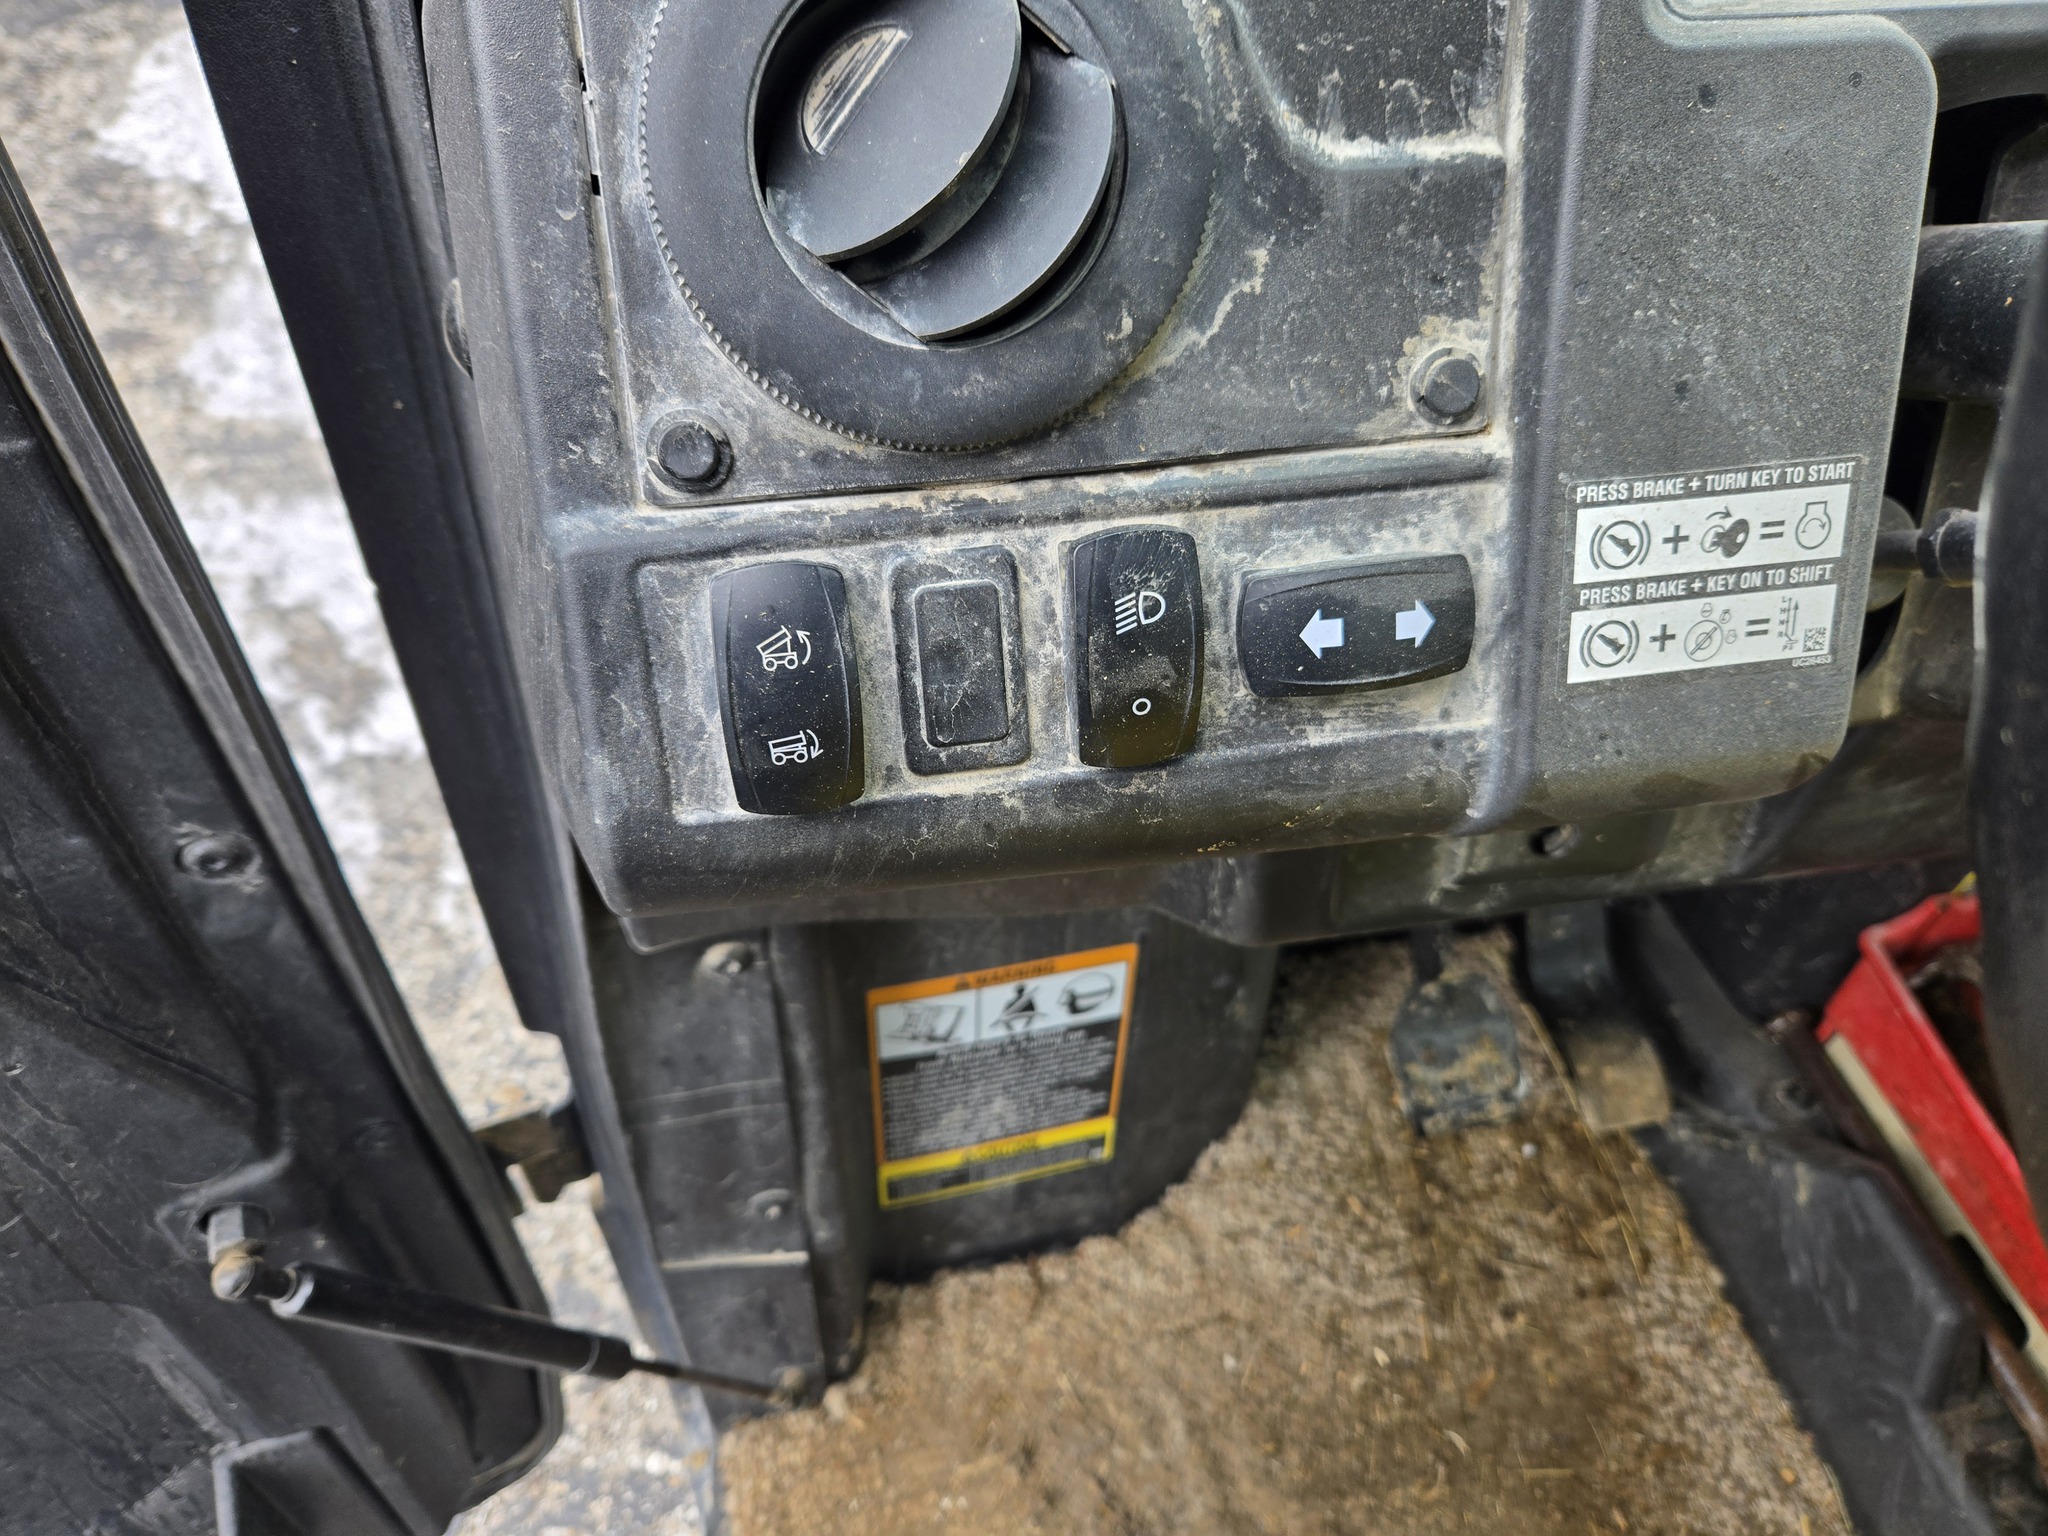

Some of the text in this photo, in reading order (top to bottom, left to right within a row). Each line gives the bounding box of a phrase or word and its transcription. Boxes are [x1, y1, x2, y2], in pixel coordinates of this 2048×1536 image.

[1576, 481, 1629, 504] PRESS
[1632, 477, 1685, 499] BRAKE
[1704, 471, 1748, 492] TURN
[1750, 467, 1782, 488] KEY
[1784, 465, 1805, 484] TO
[1807, 461, 1856, 482] START
[1579, 584, 1631, 606] PRESS
[1635, 579, 1688, 600] BRAKE
[1706, 573, 1737, 593] KEY
[1740, 571, 1762, 589] ON
[1766, 568, 1787, 586] TO
[1789, 563, 1834, 584] SHIFT
